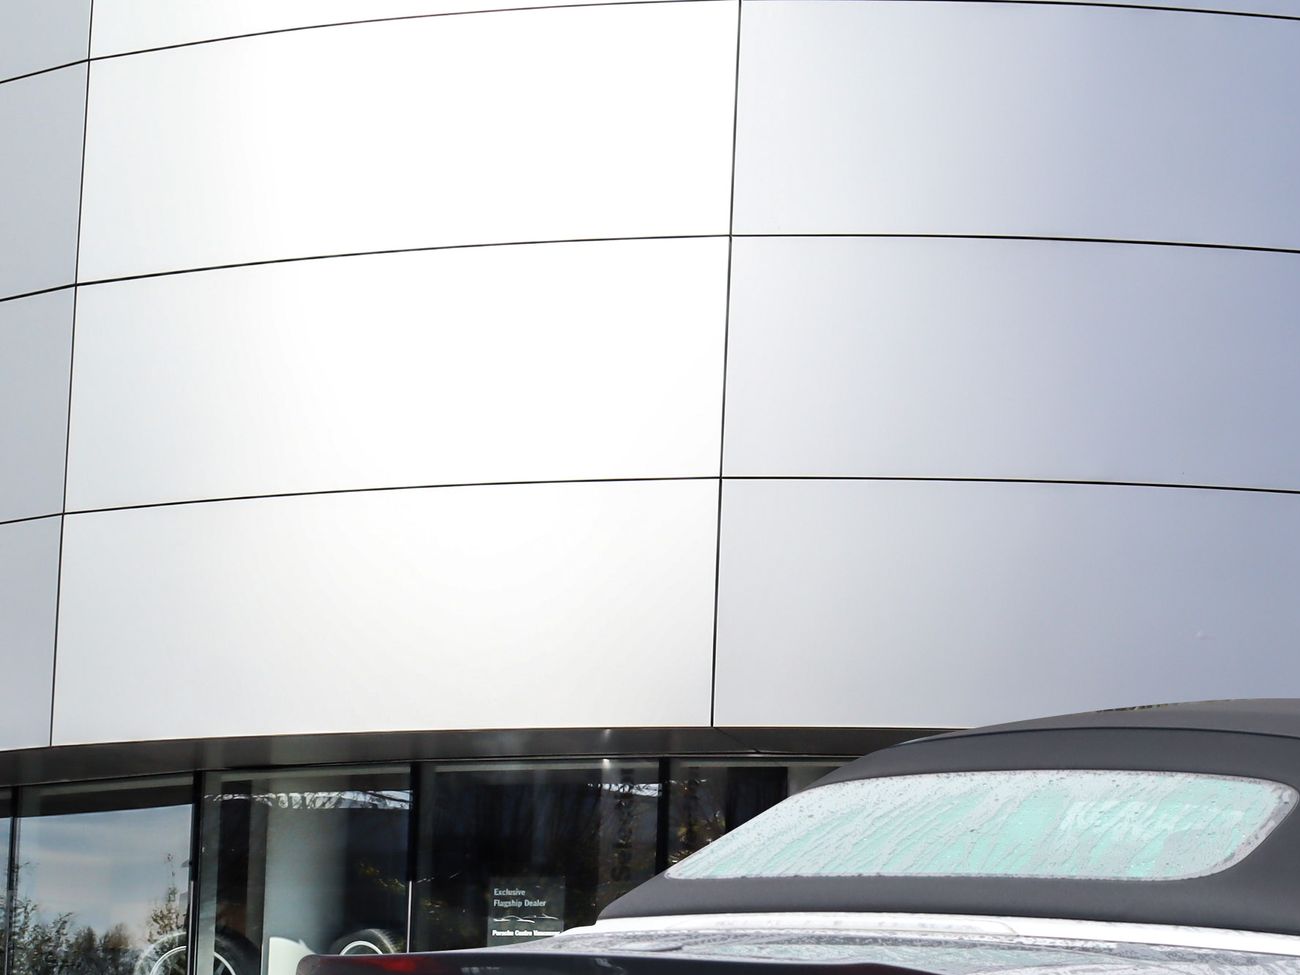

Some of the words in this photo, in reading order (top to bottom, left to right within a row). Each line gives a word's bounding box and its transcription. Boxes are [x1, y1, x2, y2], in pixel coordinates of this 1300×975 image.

[493, 888, 526, 896] Exclusive
[493, 899, 522, 908] Flagship
[524, 899, 546, 907] Dealer
